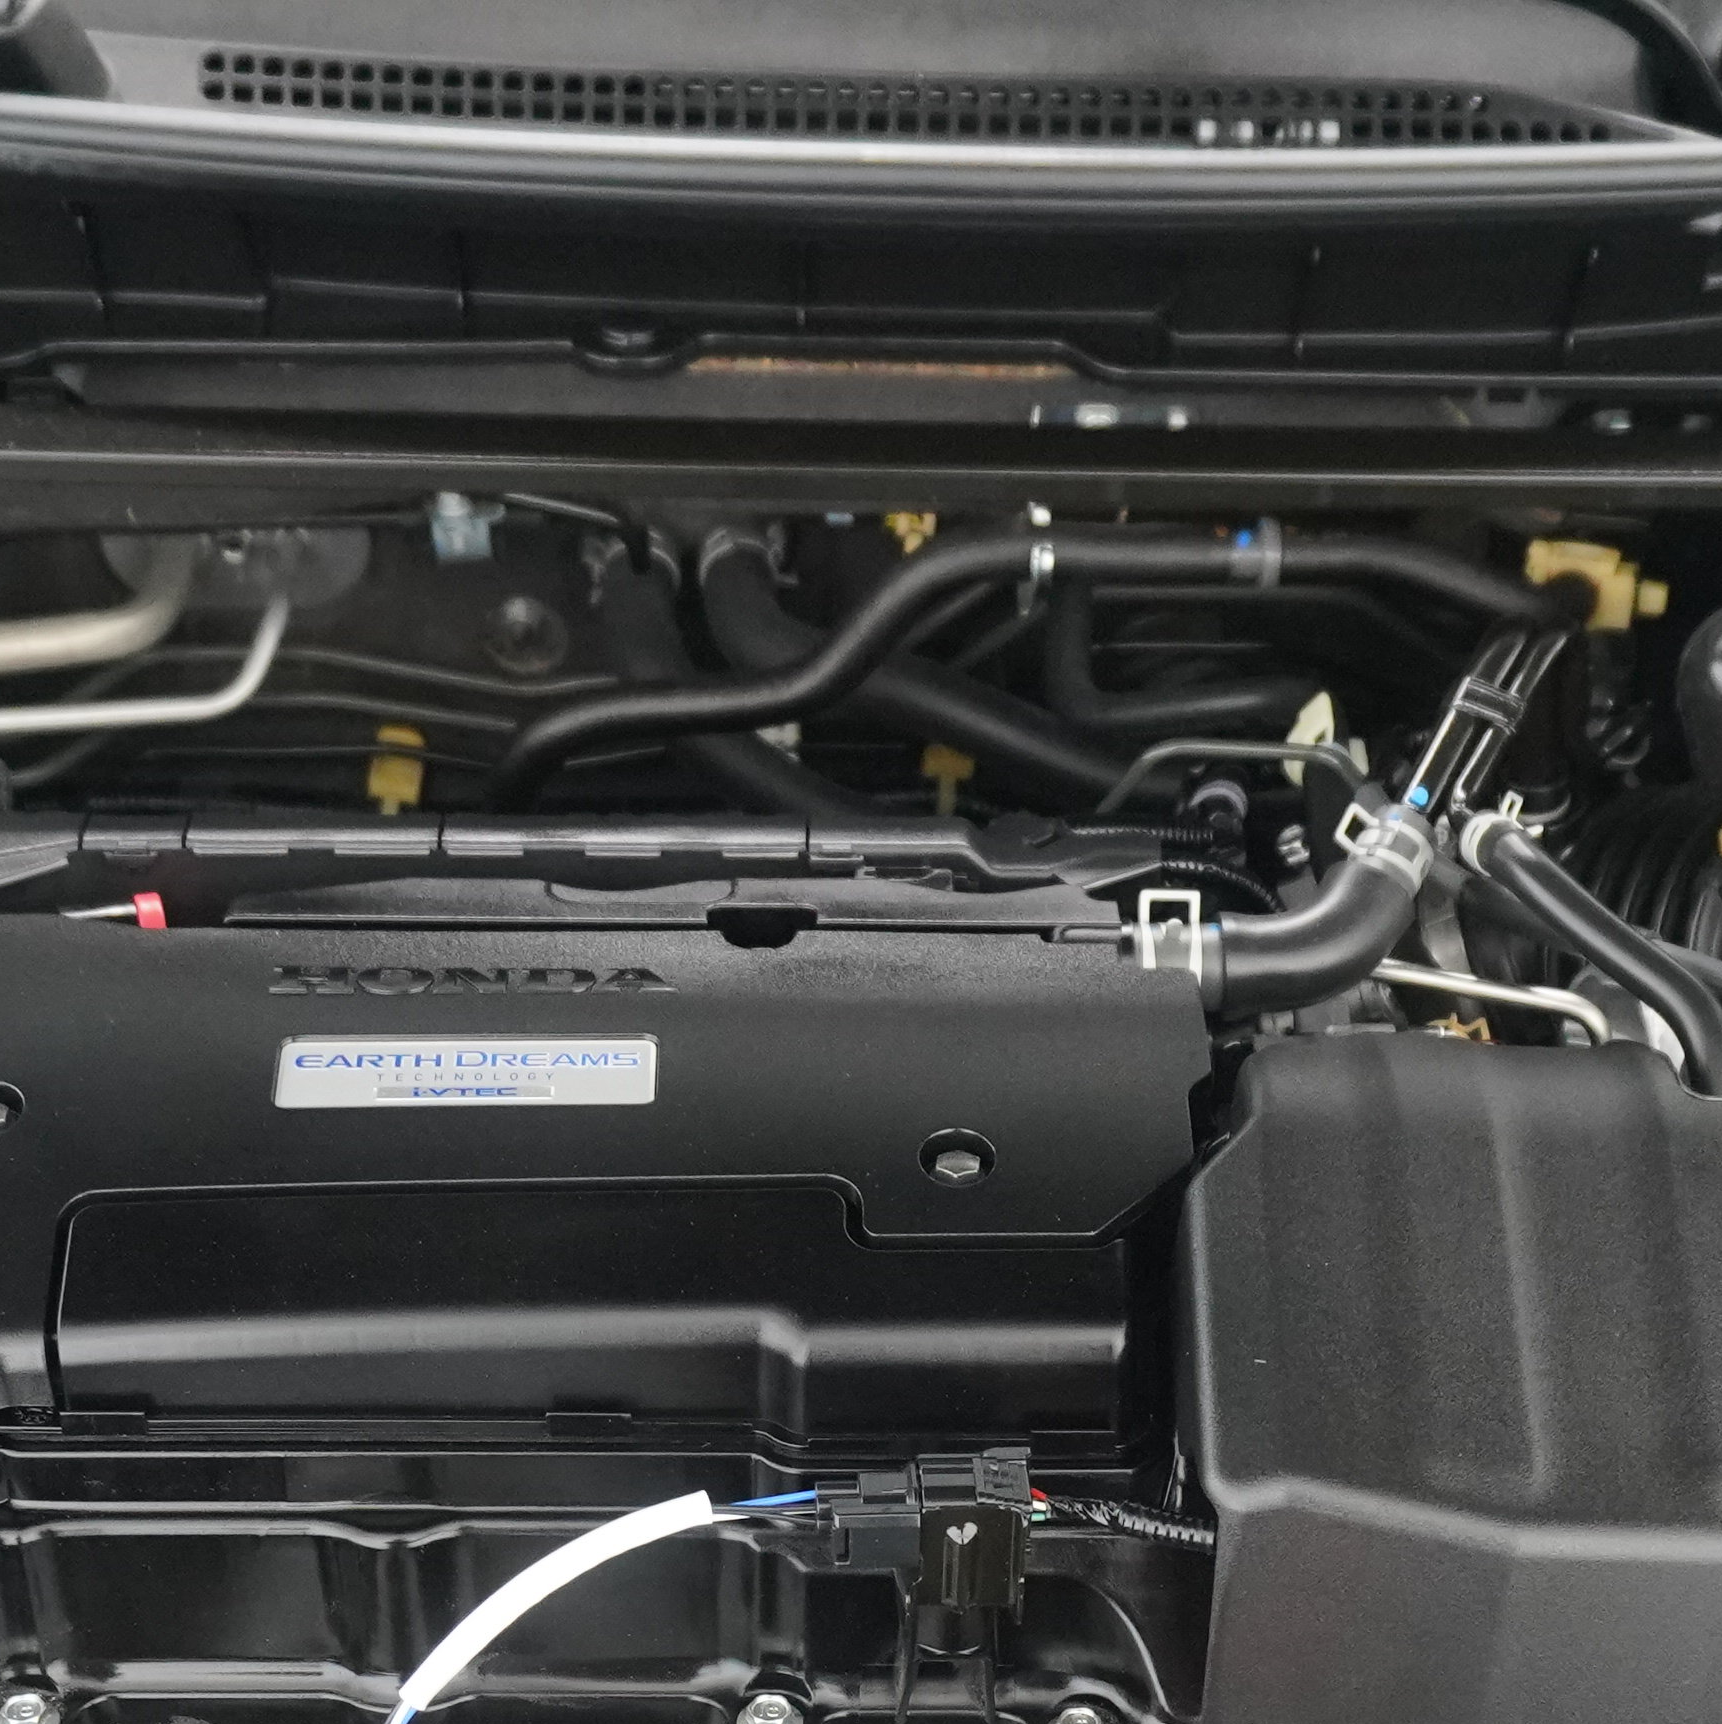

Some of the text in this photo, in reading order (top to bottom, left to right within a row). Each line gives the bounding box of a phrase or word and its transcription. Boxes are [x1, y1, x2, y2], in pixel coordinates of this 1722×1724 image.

[267, 964, 680, 996] HONDA
[294, 1049, 642, 1070] EARTH DREAMS
[376, 1071, 556, 1083] TECHNOLOGY
[412, 1085, 518, 1098] i-VTEC
